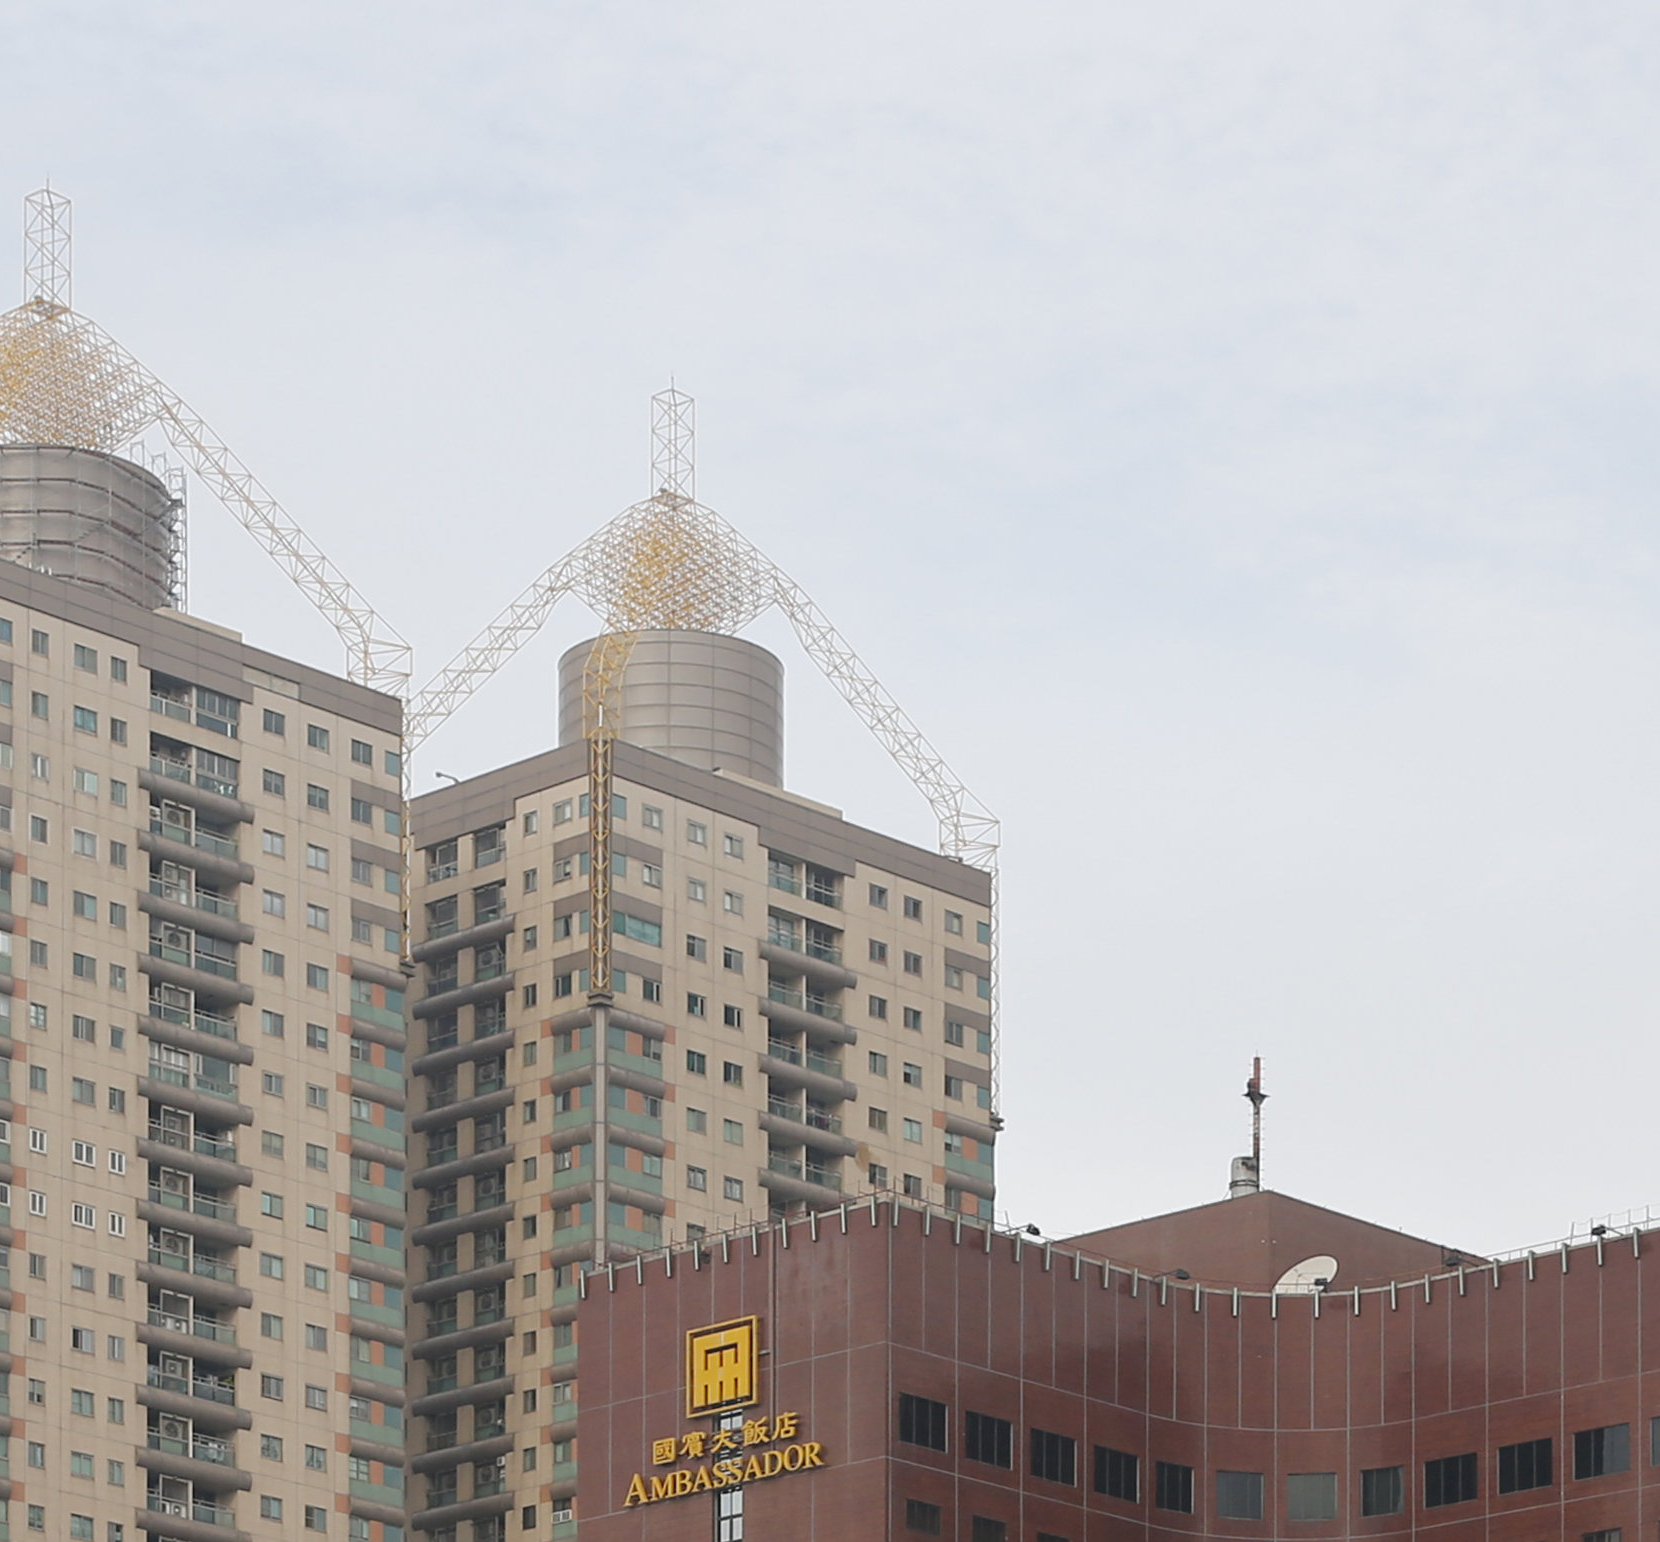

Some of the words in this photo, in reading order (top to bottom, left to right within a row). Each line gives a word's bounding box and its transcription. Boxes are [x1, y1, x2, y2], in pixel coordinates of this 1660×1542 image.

[653, 1412, 800, 1466] 國賓大飯店
[624, 1442, 825, 1507] AMBASSADOR
